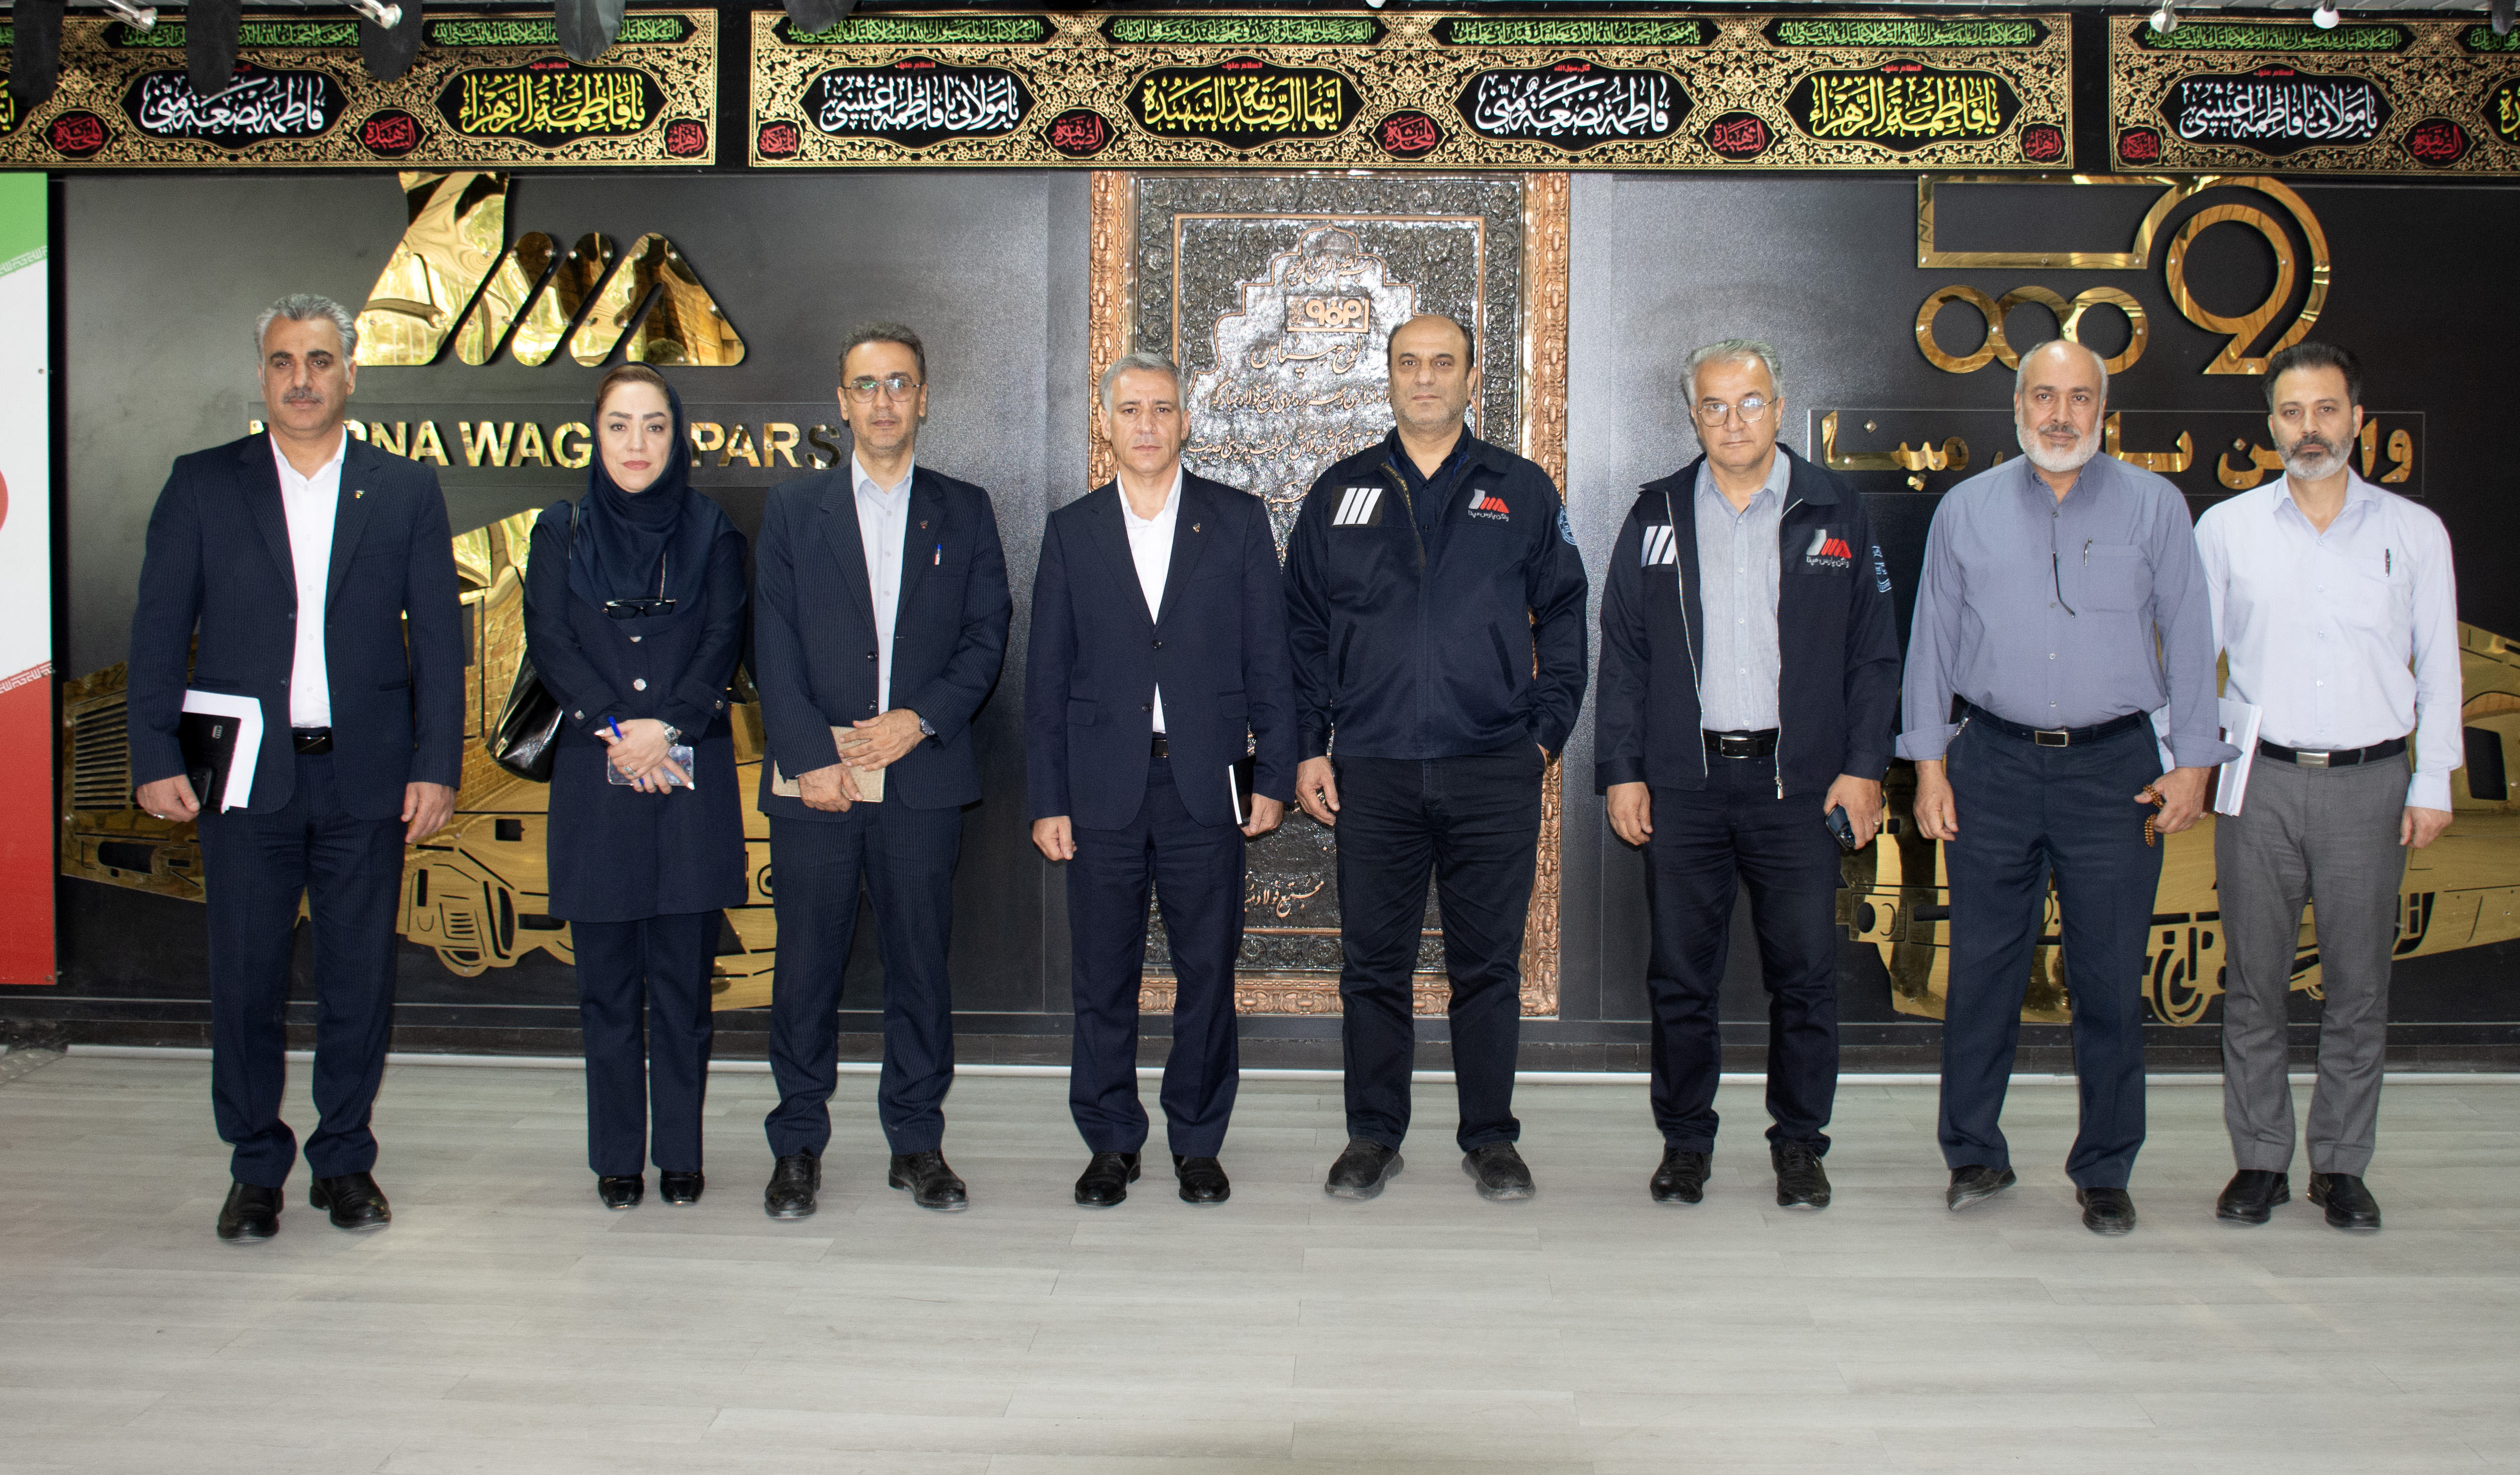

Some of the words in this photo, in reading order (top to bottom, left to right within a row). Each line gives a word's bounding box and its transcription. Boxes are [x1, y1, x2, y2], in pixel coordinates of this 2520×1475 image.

[1250, 338, 1338, 378] سپاس
[1333, 337, 1361, 374] لوح
[459, 422, 593, 469] WAG
[690, 422, 841, 470] PARS
